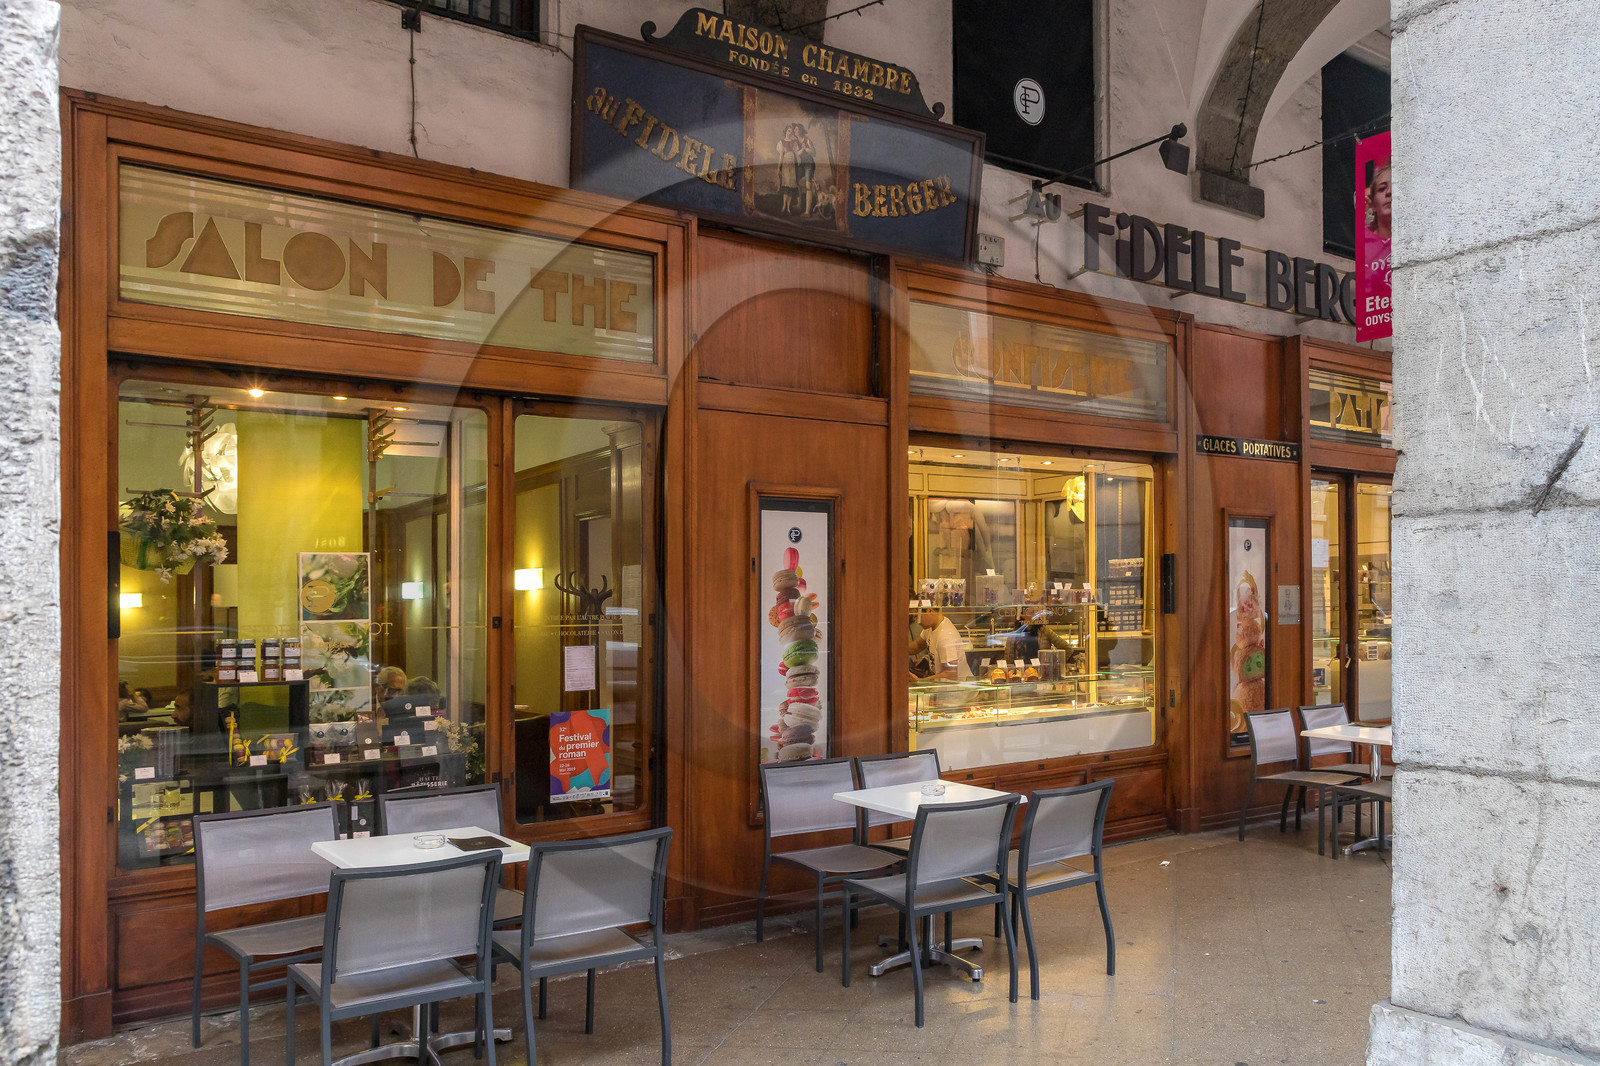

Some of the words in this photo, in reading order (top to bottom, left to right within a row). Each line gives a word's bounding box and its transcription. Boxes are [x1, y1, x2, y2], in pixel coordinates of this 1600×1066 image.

[695, 12, 791, 60] MAISON
[802, 43, 912, 95] CHAMBRE
[801, 72, 818, 86] en
[833, 80, 874, 100] 1832
[852, 174, 958, 217] BERGER
[146, 211, 388, 300] SALON
[432, 251, 496, 315] DE
[530, 267, 638, 334] THE
[1365, 295, 1392, 313] Ete
[1365, 312, 1393, 327] ODYS
[1203, 438, 1237, 453] GLACES
[1243, 442, 1291, 458] PORTATIVES
[559, 732, 592, 743] Festival
[566, 741, 600, 752] premier
[559, 750, 587, 759] roman
